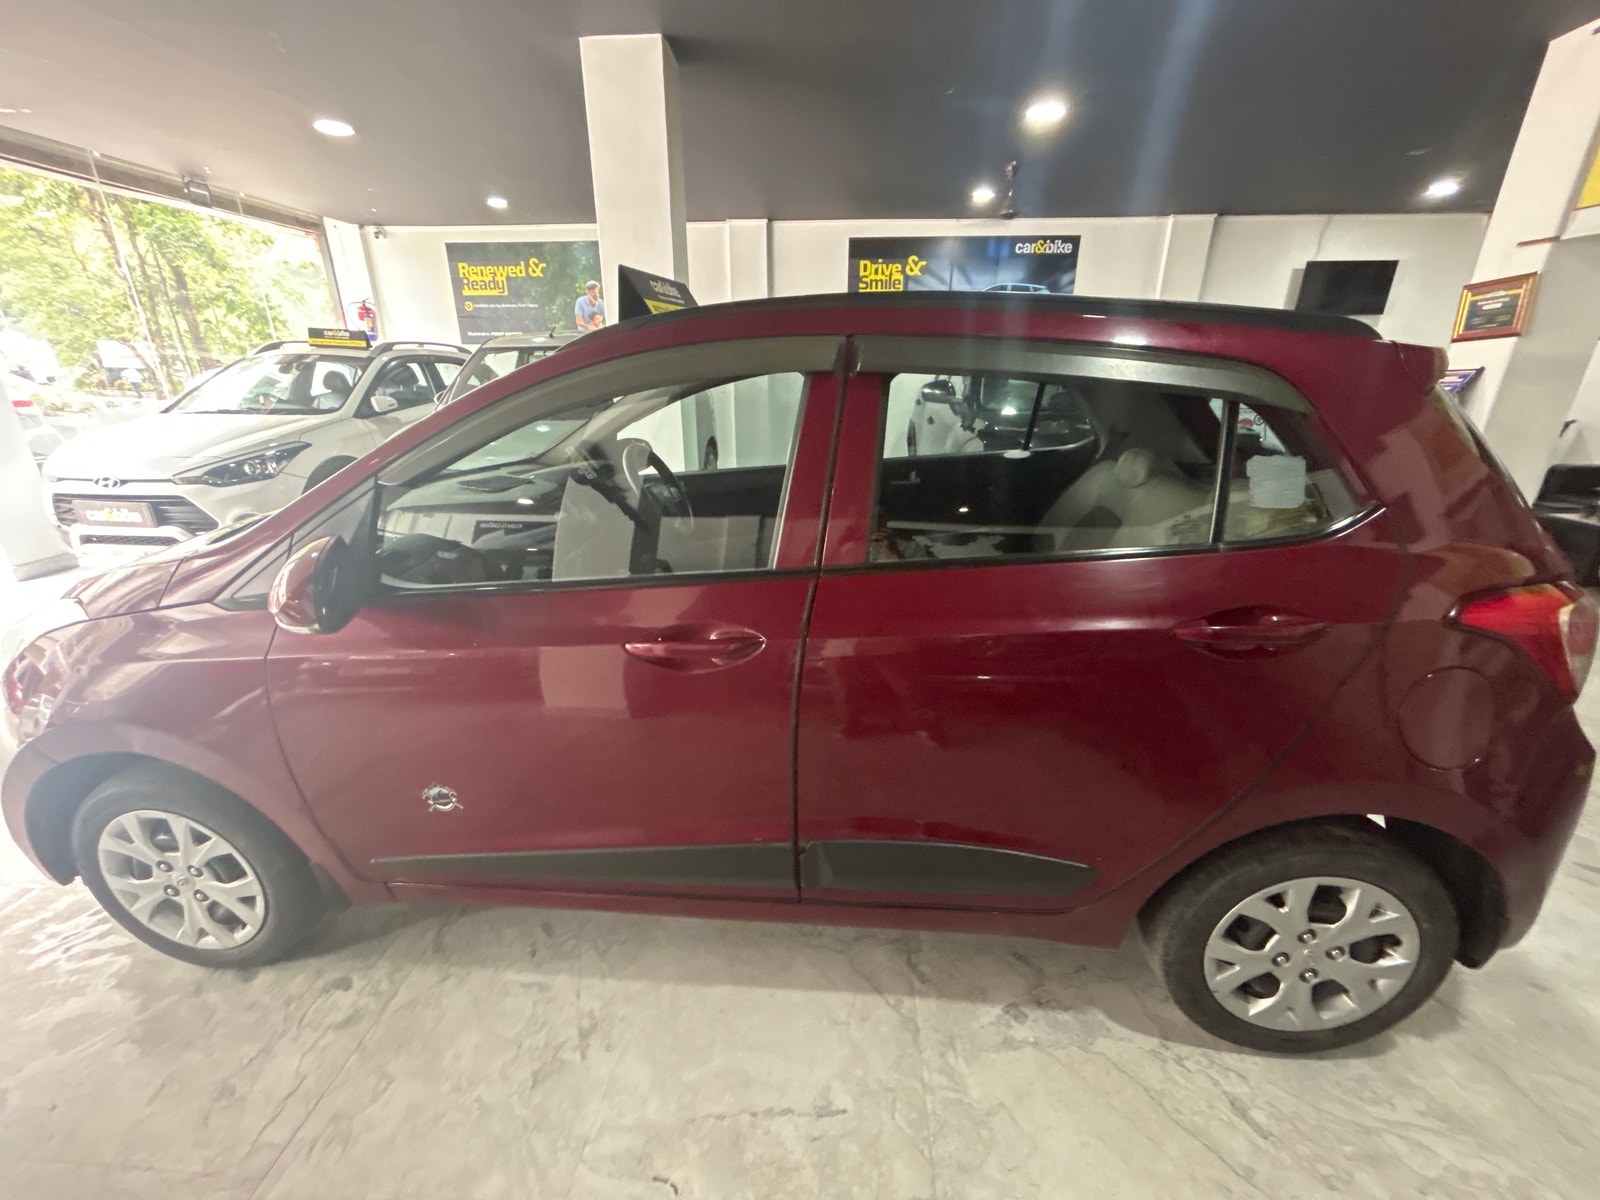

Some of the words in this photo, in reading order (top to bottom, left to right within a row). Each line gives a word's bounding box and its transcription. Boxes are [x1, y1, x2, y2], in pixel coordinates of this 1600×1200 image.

[1015, 240, 1073, 254] car&bike
[457, 260, 526, 278] Renewed
[528, 257, 547, 277] &
[859, 258, 902, 277] Drive
[905, 255, 927, 276] &
[462, 276, 506, 294] Ready
[858, 275, 902, 290] Smile
